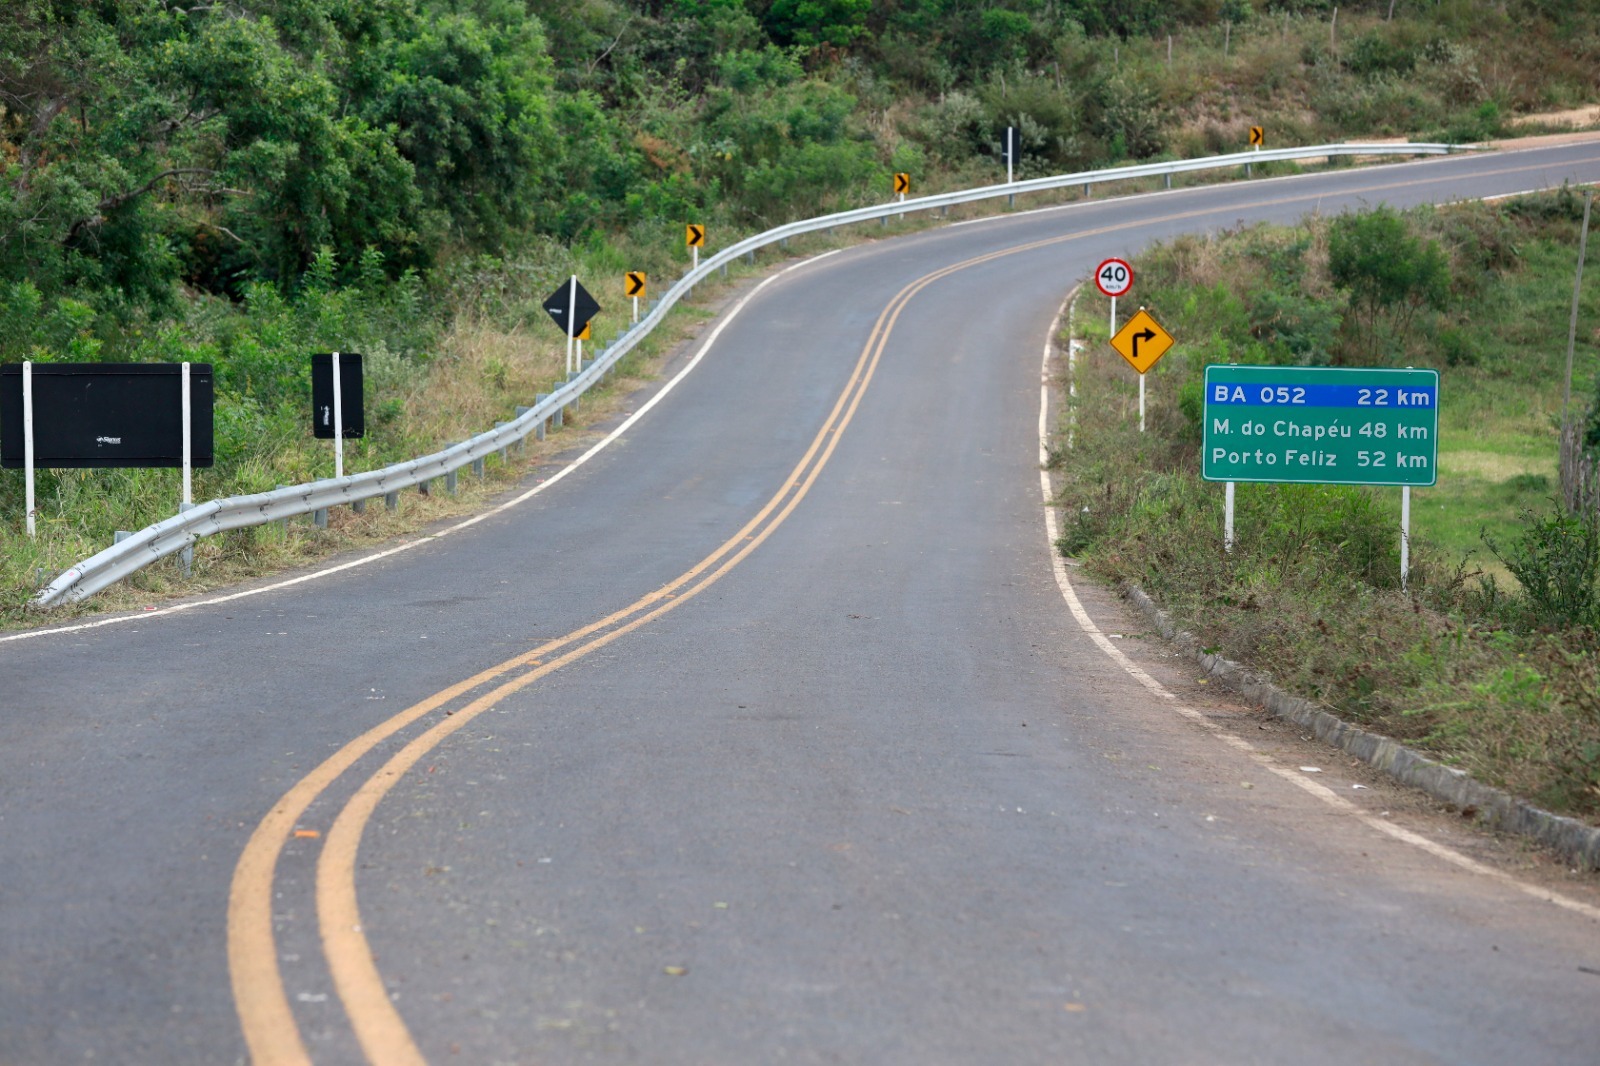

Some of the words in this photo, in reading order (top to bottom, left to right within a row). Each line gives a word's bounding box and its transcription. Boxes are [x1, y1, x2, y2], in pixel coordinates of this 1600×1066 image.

[1101, 266, 1126, 282] 40
[1214, 385, 1246, 403] BA
[1260, 387, 1306, 404] 052
[1357, 389, 1389, 406] 22
[1397, 389, 1429, 406] km
[1213, 418, 1234, 435] M.
[1241, 420, 1266, 436] do
[1273, 419, 1351, 441] Chapéu
[1358, 422, 1387, 438] 48
[1397, 423, 1428, 439] km
[1212, 448, 1277, 465] Porto
[1285, 449, 1337, 467] Feliz
[1357, 451, 1386, 467] 52
[1396, 451, 1428, 468] km
